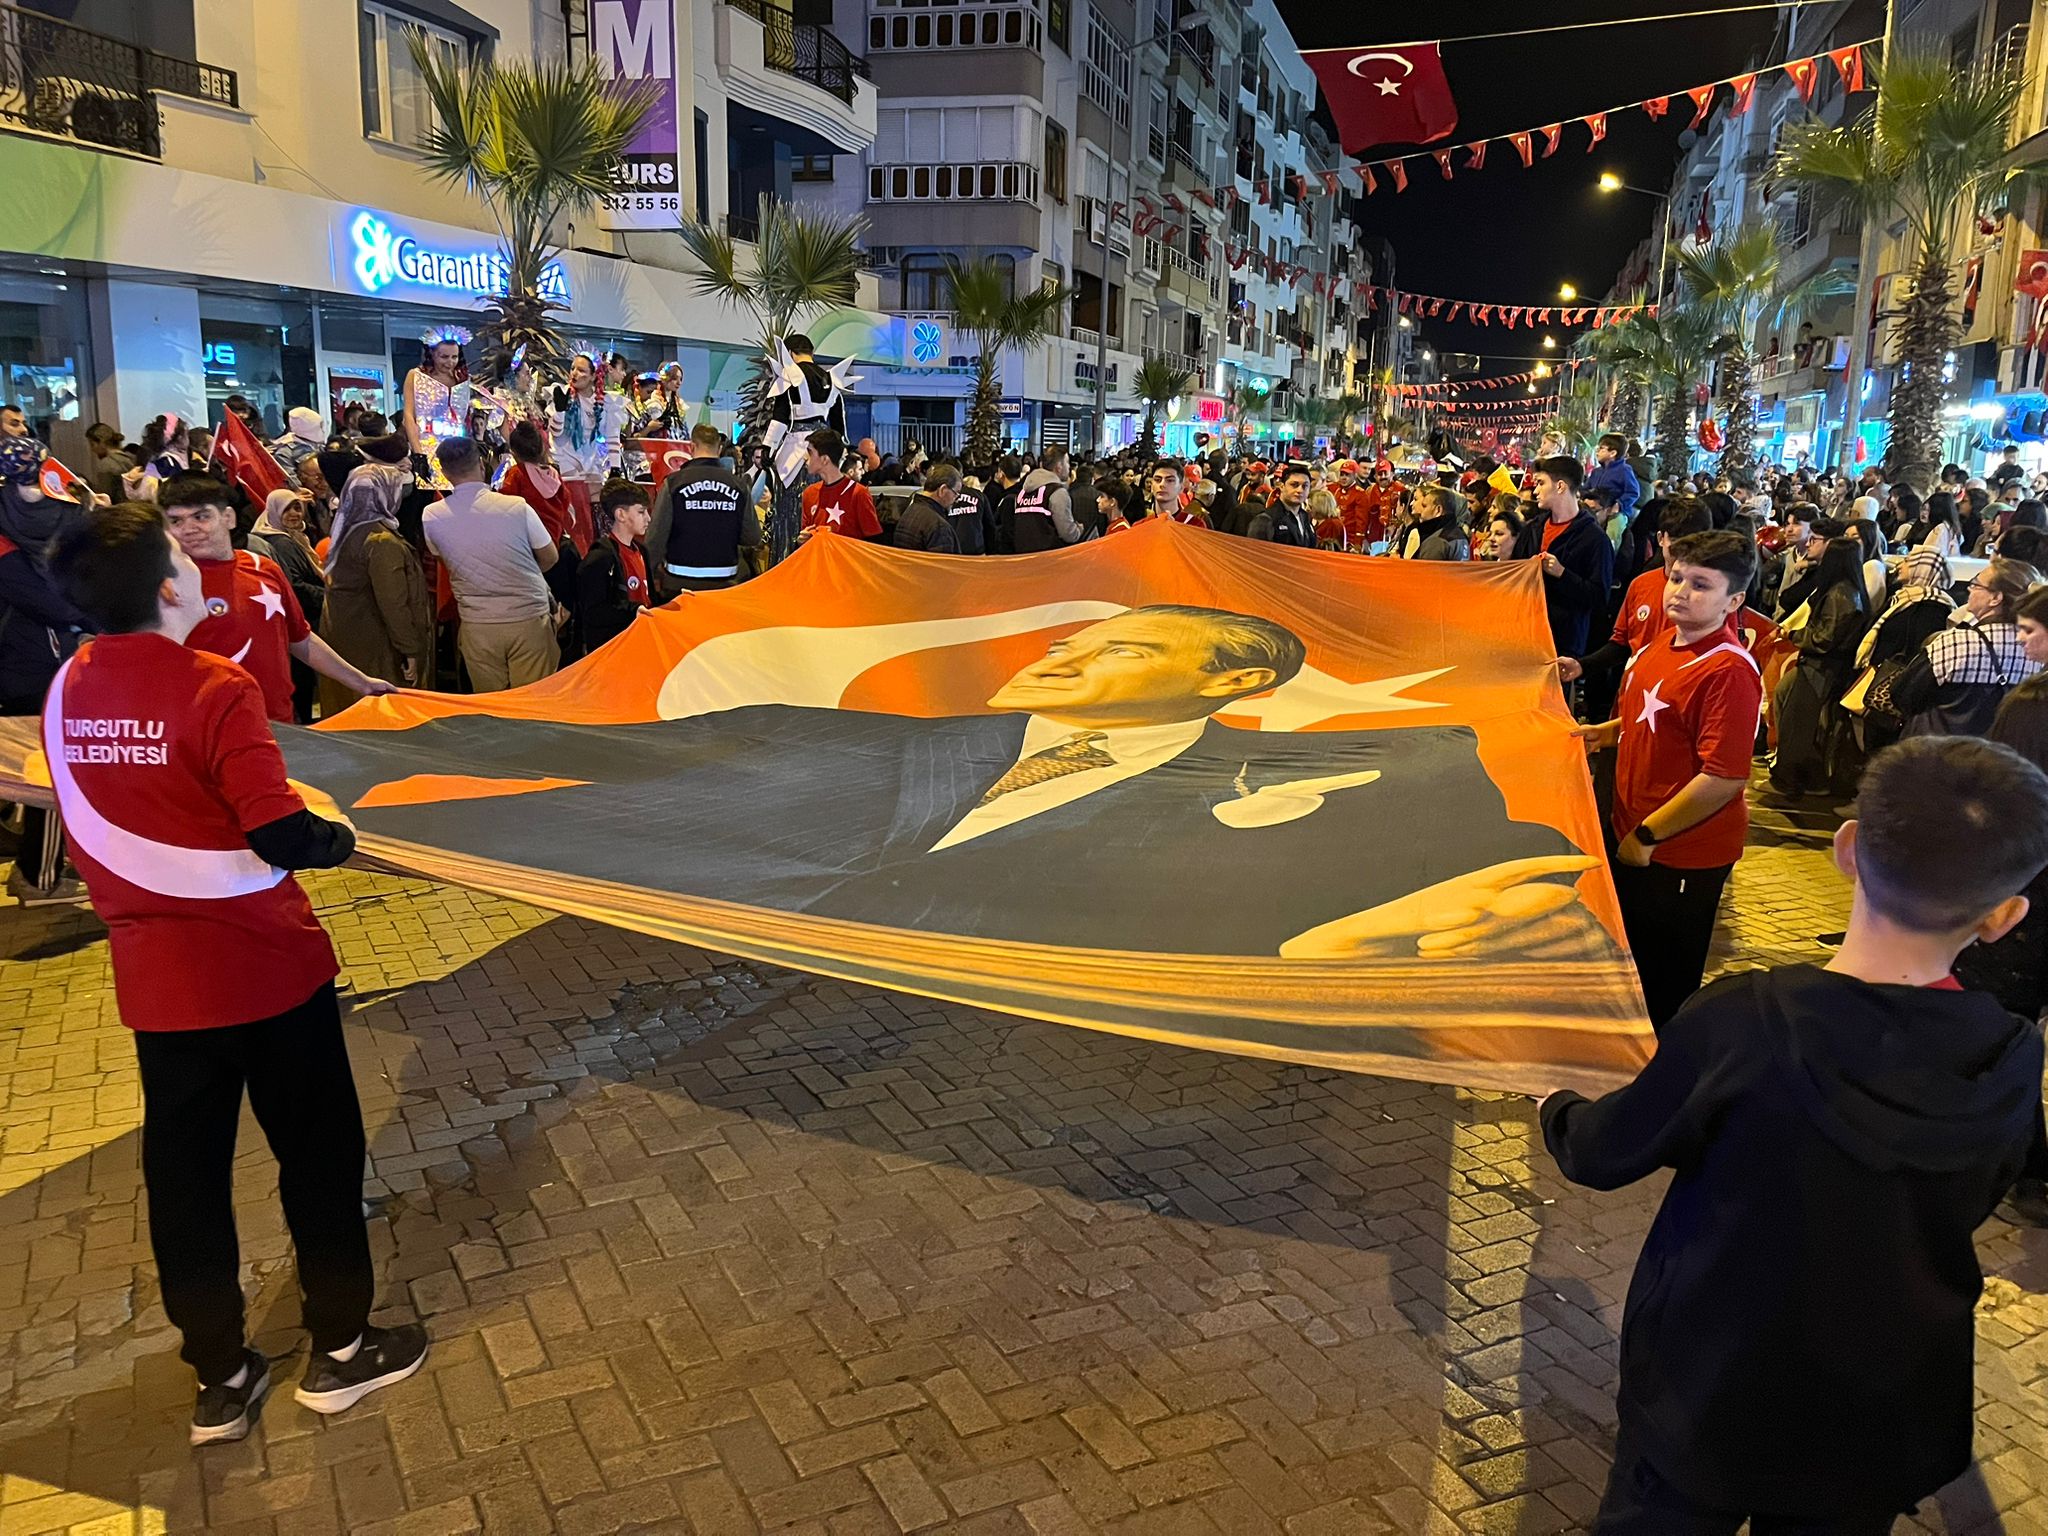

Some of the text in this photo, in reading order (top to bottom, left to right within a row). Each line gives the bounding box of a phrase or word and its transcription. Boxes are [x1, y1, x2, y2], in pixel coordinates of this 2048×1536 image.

[595, 0, 672, 80] M
[636, 197, 655, 210] 55
[660, 197, 679, 210] 56
[679, 480, 740, 500] TURGUTLU
[685, 500, 736, 511] BELEDİYESİ
[64, 719, 164, 740] TURGUTLU
[64, 741, 168, 765] BELEDİYESİ
